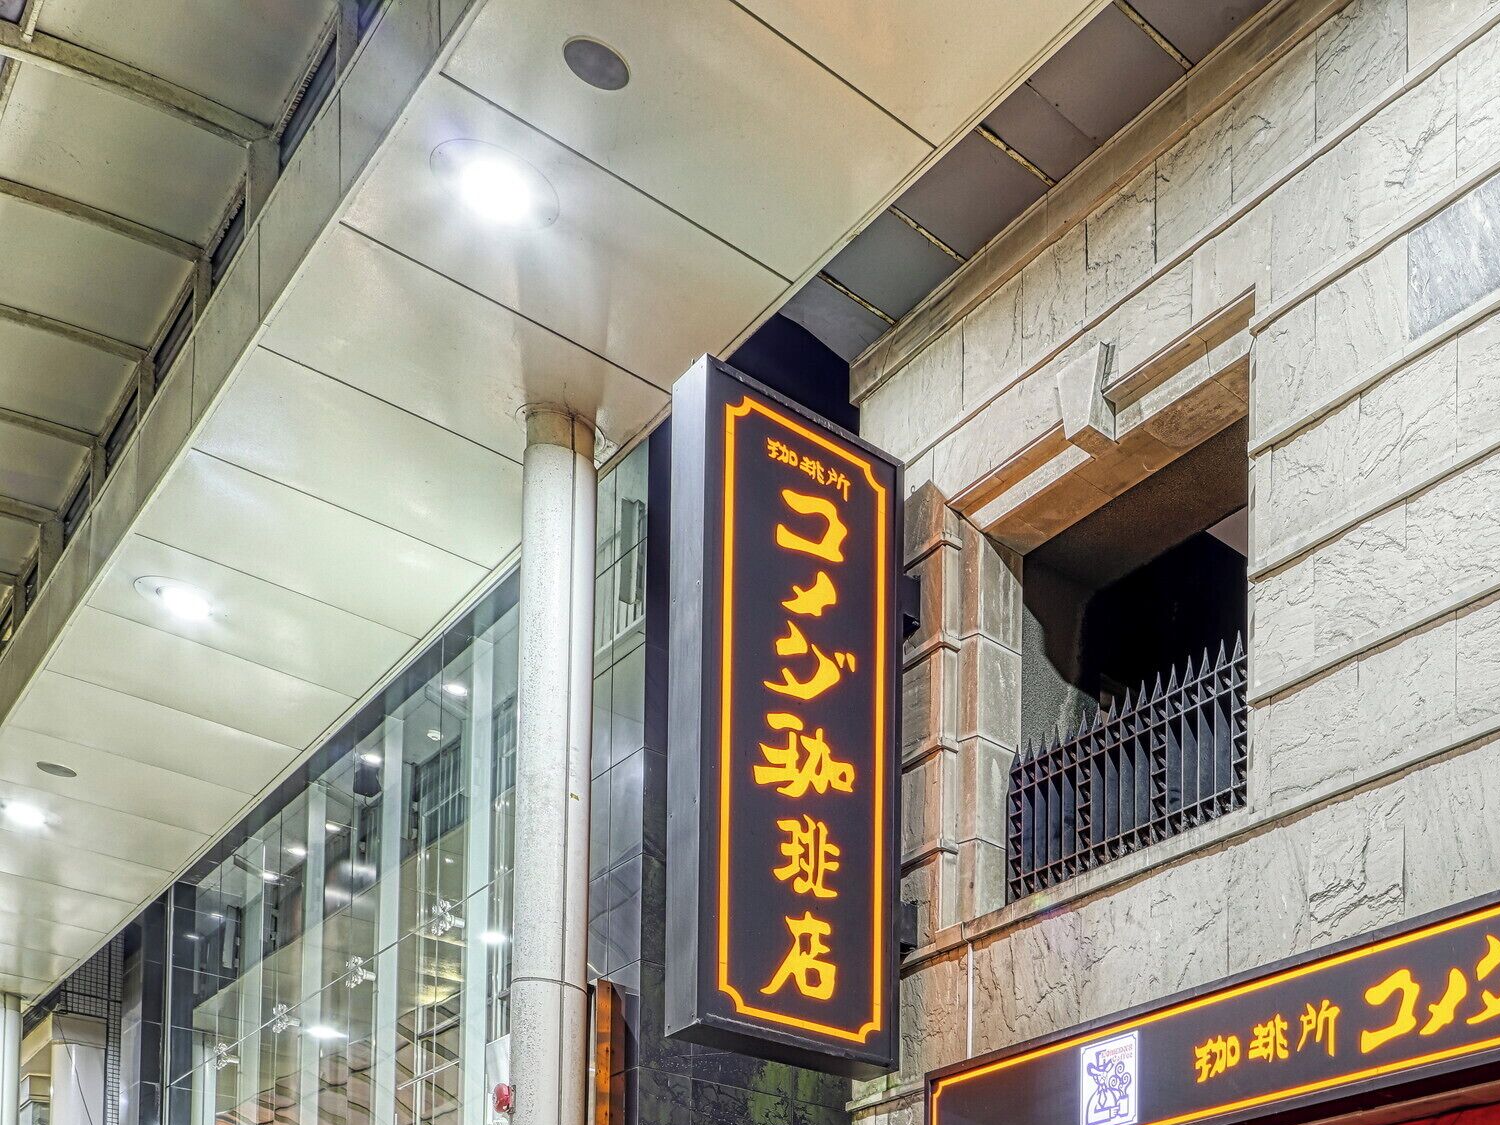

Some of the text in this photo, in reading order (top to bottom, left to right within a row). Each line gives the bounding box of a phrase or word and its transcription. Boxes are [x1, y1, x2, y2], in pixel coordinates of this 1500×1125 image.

[753, 488, 856, 999] コメダ珈琲店
